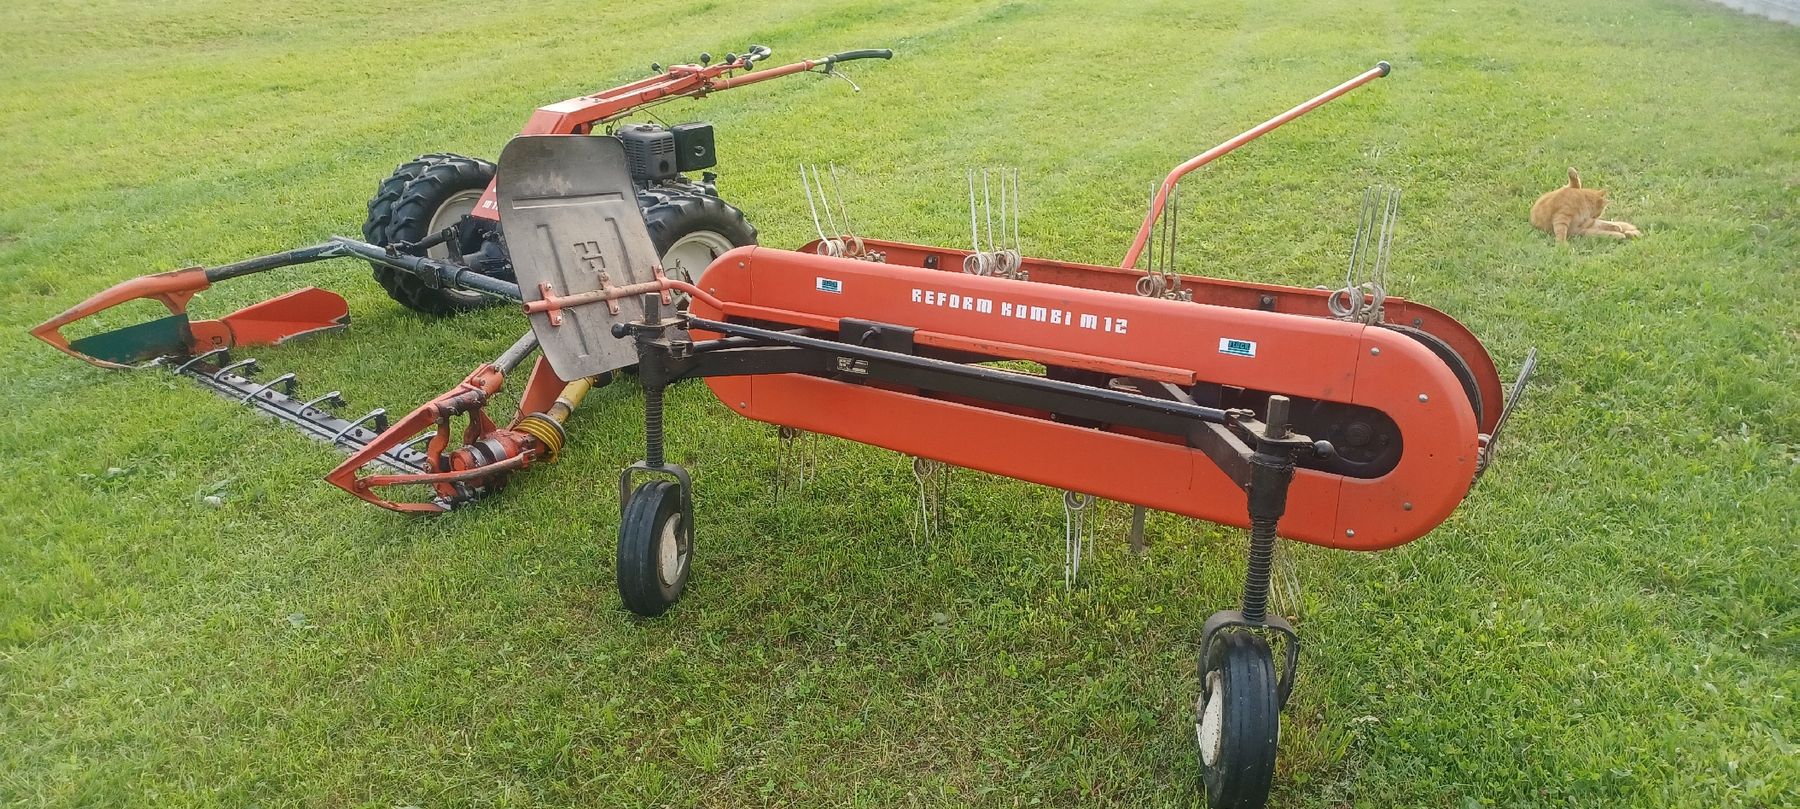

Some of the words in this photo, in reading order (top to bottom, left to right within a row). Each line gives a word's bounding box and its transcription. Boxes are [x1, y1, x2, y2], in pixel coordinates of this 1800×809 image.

[911, 288, 993, 314] REFORM
[1079, 313, 1098, 330] M
[1103, 316, 1128, 334] 12
